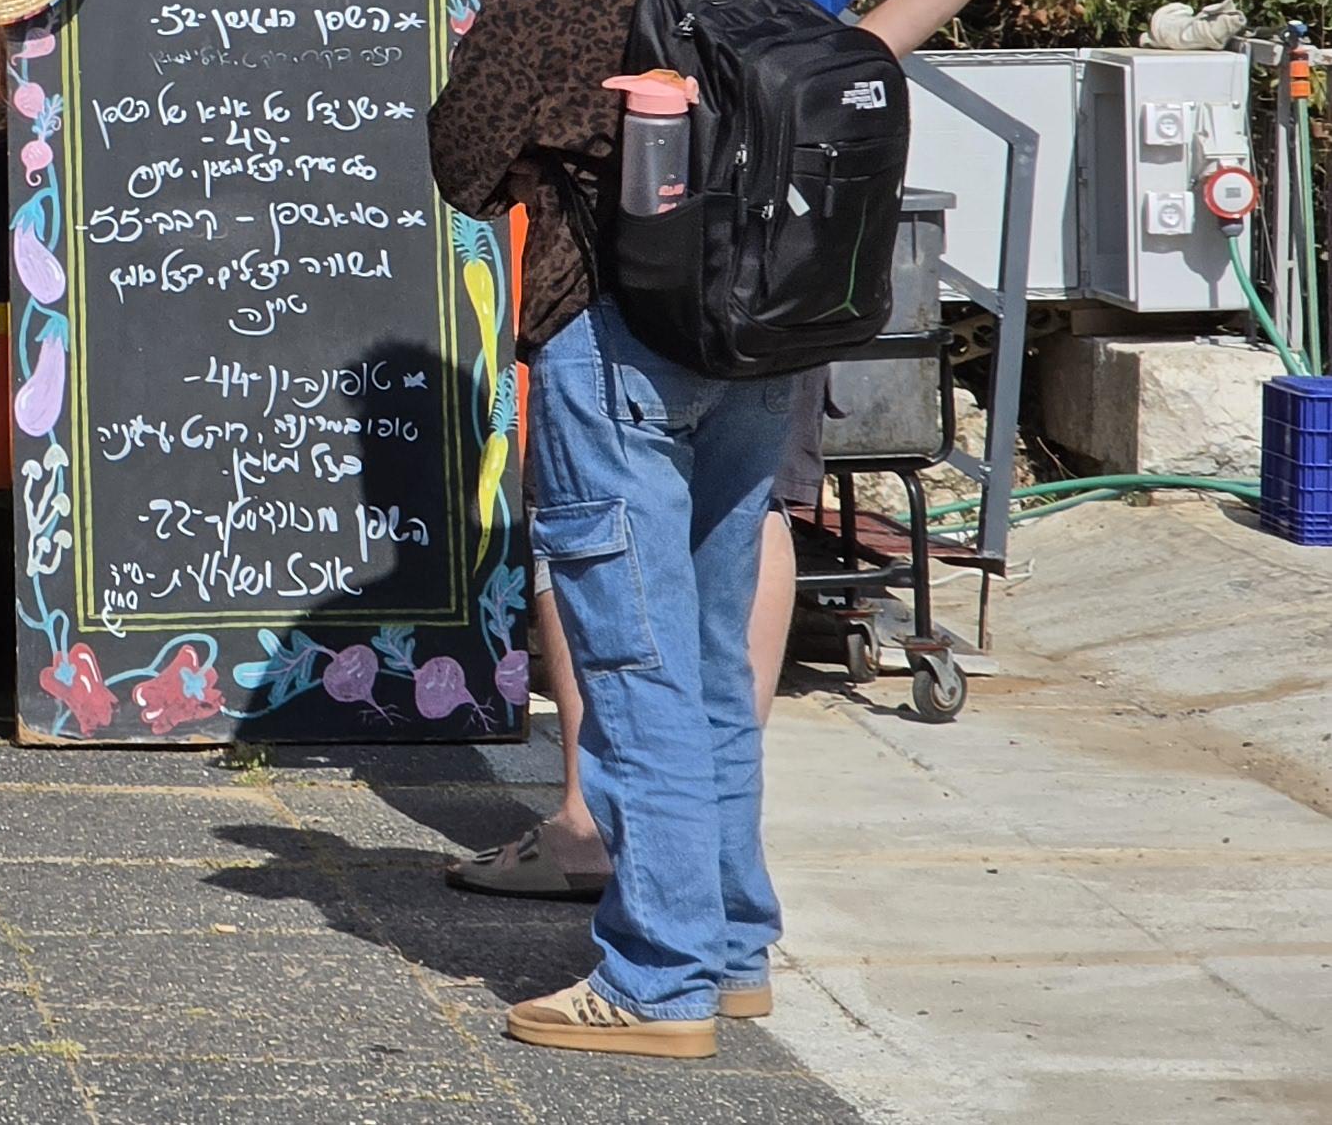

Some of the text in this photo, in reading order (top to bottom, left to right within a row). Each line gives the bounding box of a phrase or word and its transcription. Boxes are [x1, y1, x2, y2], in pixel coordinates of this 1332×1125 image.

[313, 5, 391, 46] השפן
[92, 96, 151, 150] השפן
[156, 81, 187, 126] של
[196, 95, 252, 123] אמא
[263, 90, 291, 123] של
[354, 501, 430, 563] השפן
